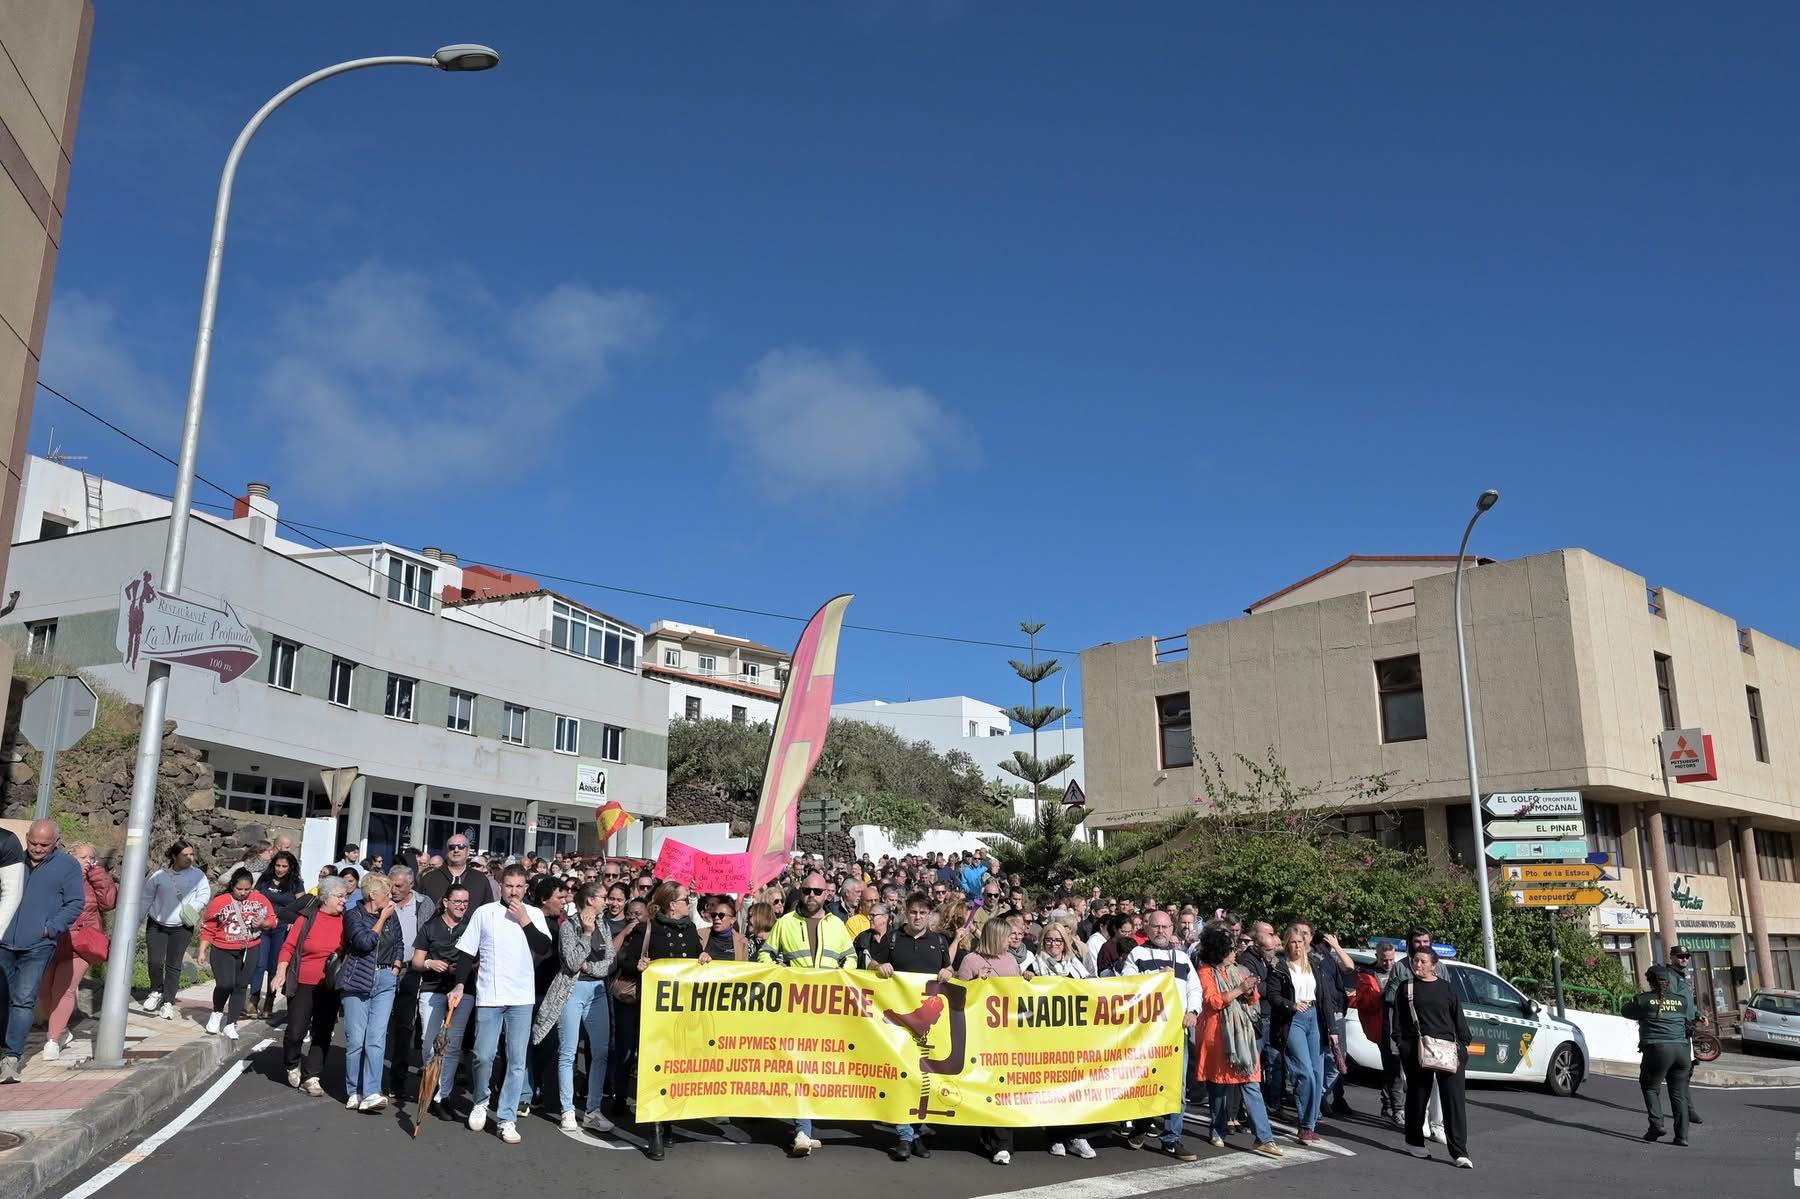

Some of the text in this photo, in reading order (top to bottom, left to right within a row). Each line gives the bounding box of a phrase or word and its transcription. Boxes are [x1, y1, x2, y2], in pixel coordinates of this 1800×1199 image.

[143, 620, 252, 649] La Mirada Profunda
[210, 658, 223, 669] 100
[1511, 795, 1540, 803] GOLFO
[1550, 824, 1578, 832] PINAR
[1528, 891, 1576, 902] aeropuerto
[656, 980, 874, 1018] EL HIERRO MUERE
[985, 991, 1168, 1028] SI NADIE ACTUA
[1487, 1027, 1510, 1040] CIVIL
[718, 1036, 845, 1053] SIN PYMES NO HAY ISLA
[980, 1052, 1009, 1067] TRATO
[1011, 1050, 1075, 1067] EQUILIBRADO
[1076, 1049, 1101, 1064] PARA
[1103, 1048, 1122, 1062] UNA
[1124, 1047, 1146, 1061] ISLA
[663, 1058, 898, 1080] FISCALIDAD JUSTA PARA UNA ISLA PEQUEÑA
[1006, 1071, 1042, 1085] MENOS
[1089, 1065, 1110, 1081] MÁS
[670, 1080, 877, 1099] QUEREMOS TRABAJAR, NO SOBREVIVIR
[994, 1092, 1011, 1106] SIN
[1069, 1089, 1083, 1103] NO
[1084, 1088, 1103, 1102] HAY
[1105, 1083, 1158, 1101] DESARROLLO
